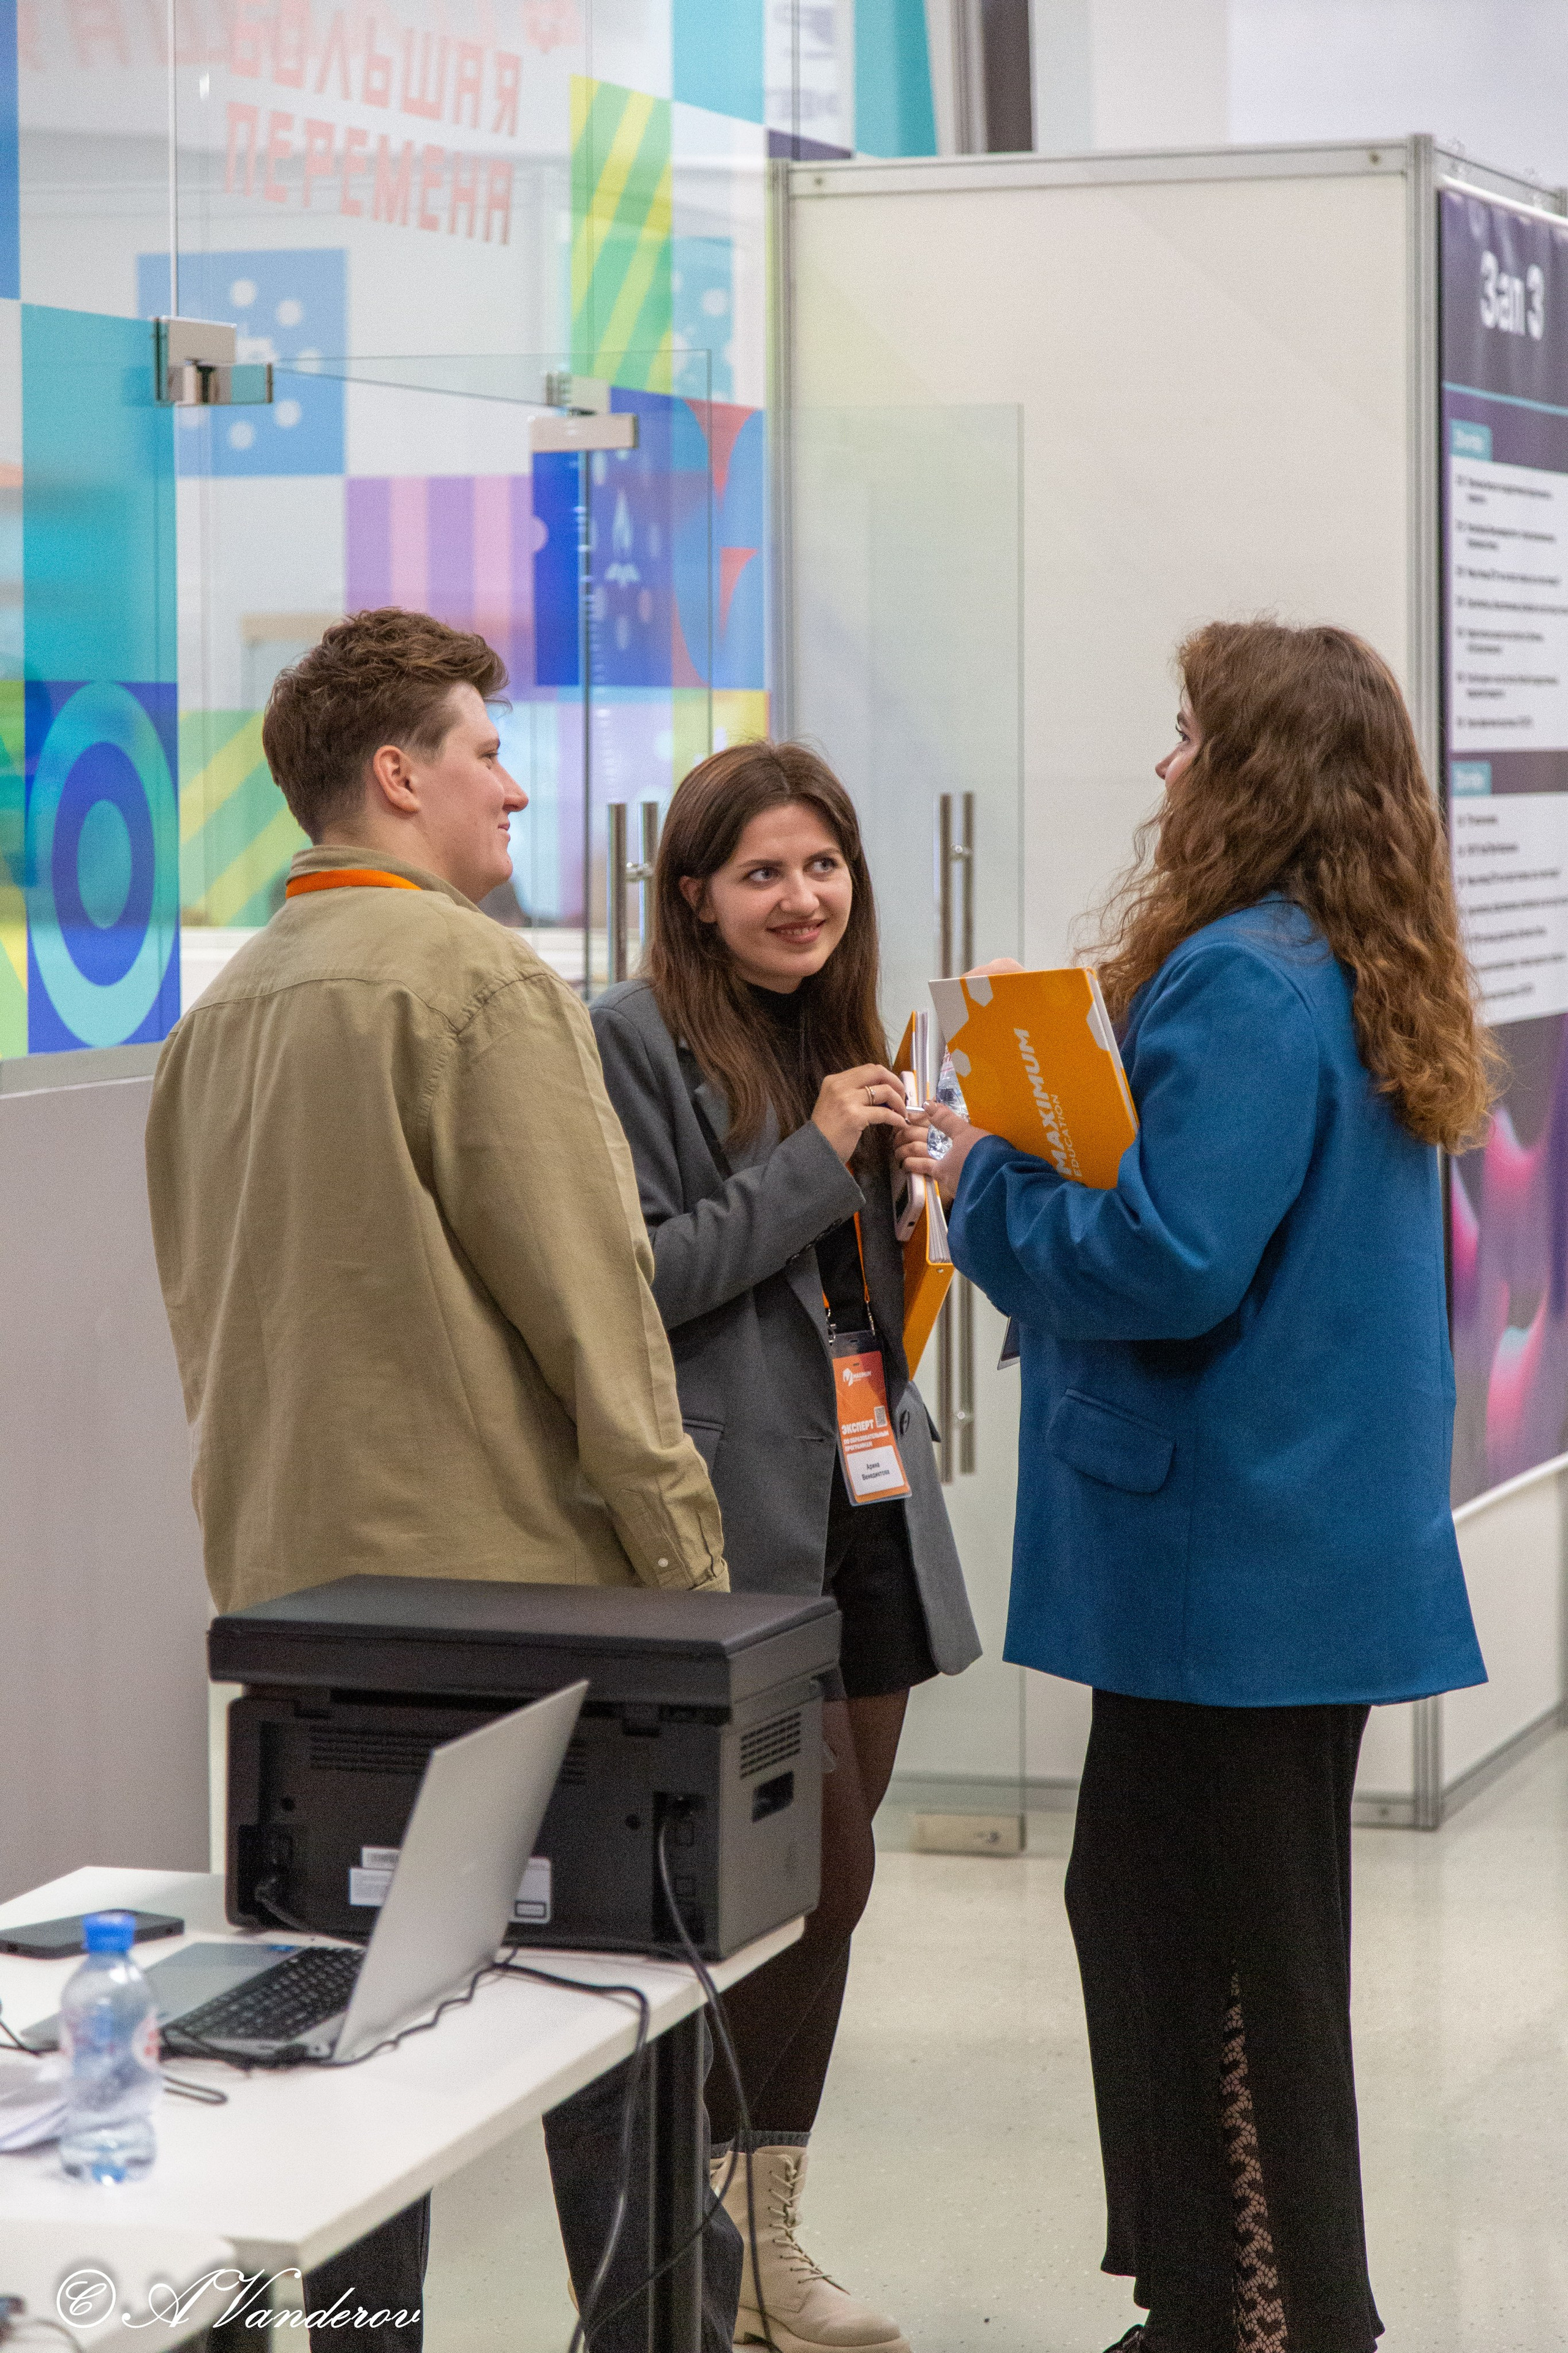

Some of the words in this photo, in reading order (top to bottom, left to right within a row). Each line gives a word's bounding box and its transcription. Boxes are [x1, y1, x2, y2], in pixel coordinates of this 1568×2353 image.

[230, 0, 522, 137] БОЛЬШАЯ
[225, 101, 514, 246] ПЕРЕМЕНА
[1526, 263, 1545, 341] 3
[1014, 1028, 1072, 1176] MAXIMUM
[1051, 1094, 1082, 1177] EDUCATION
[842, 1419, 874, 1435] ЭКСПЕРТ
